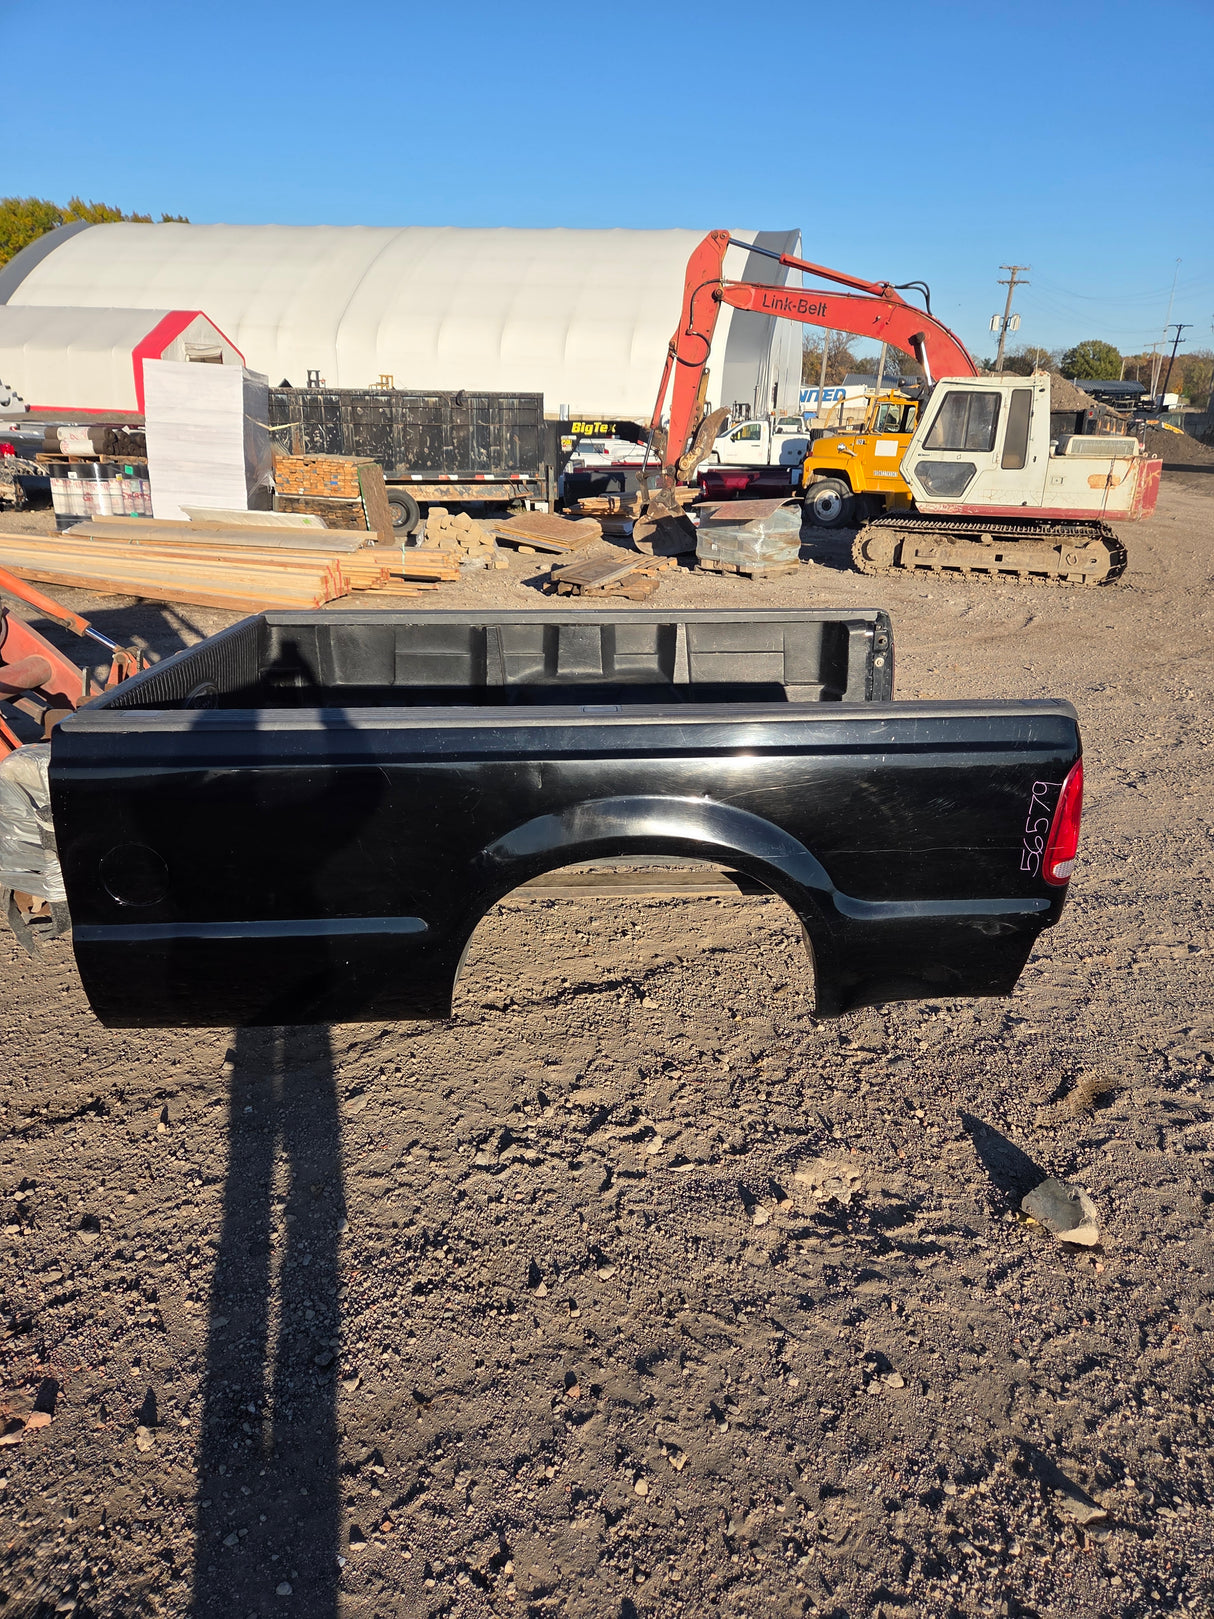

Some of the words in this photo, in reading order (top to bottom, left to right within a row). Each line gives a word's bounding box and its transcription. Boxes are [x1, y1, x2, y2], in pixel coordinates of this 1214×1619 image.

[762, 293, 827, 317] Link-Belt
[800, 388, 846, 403] NITED
[571, 422, 616, 435] BigTex
[1020, 781, 1062, 878] 56579
